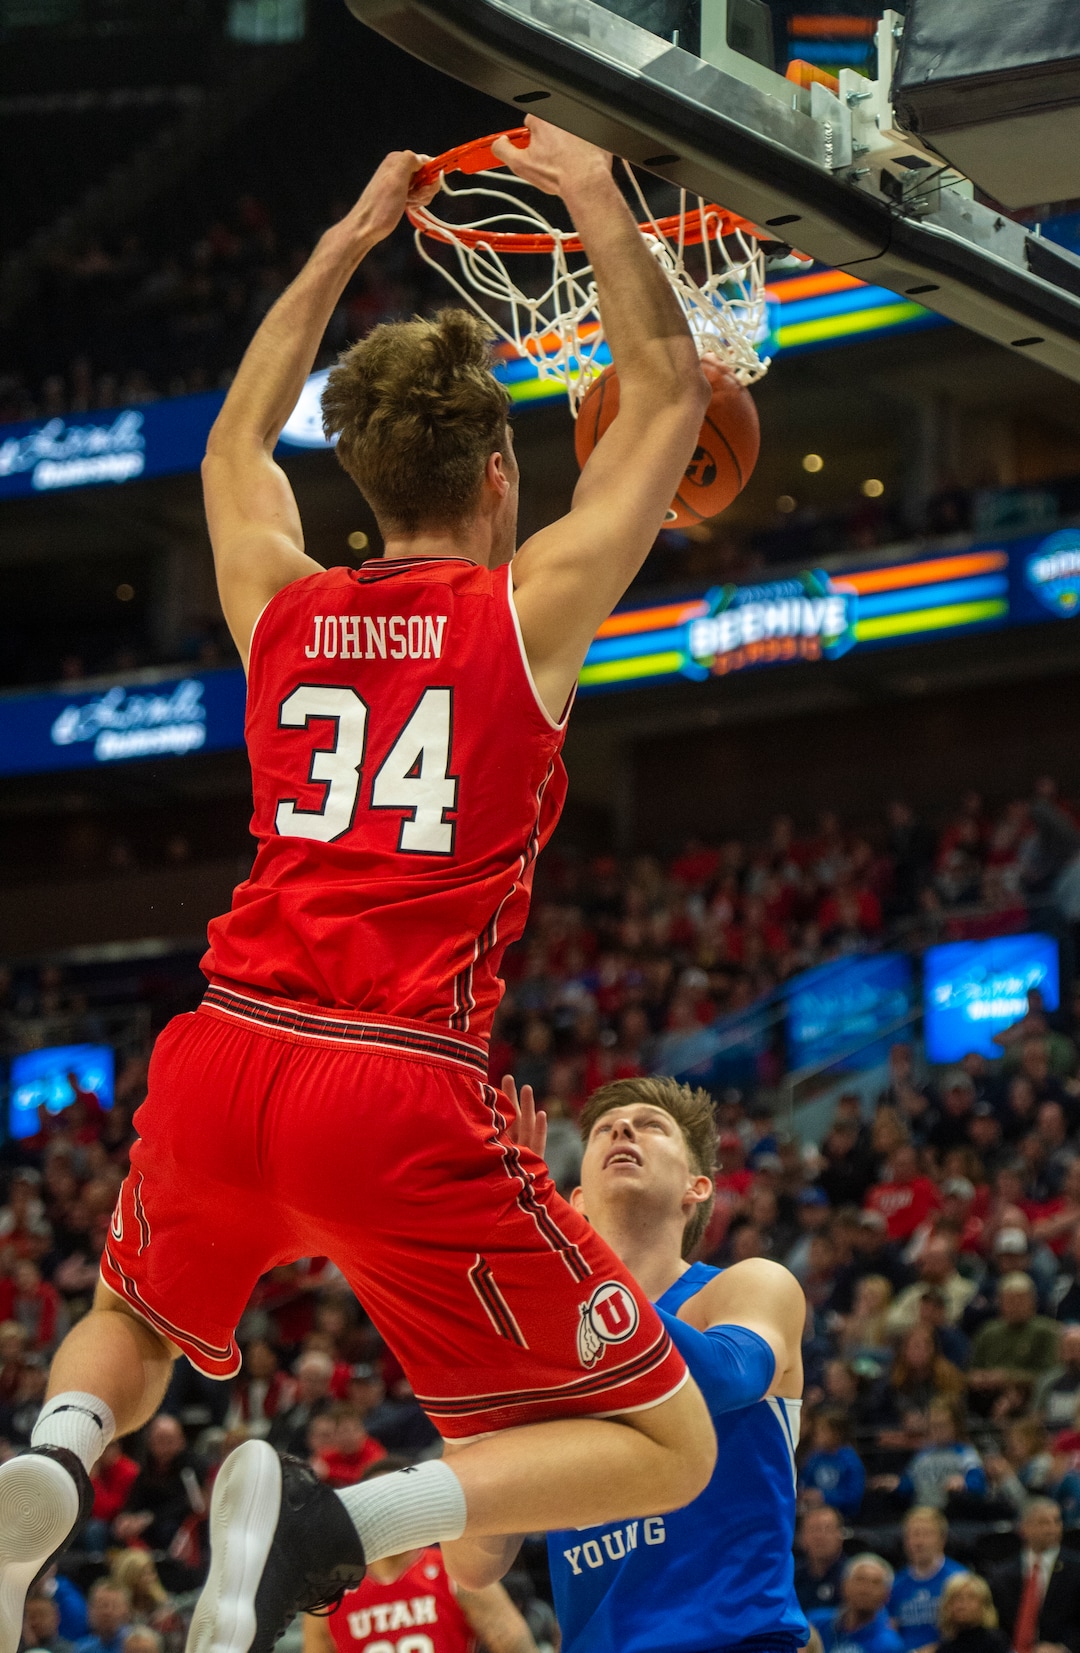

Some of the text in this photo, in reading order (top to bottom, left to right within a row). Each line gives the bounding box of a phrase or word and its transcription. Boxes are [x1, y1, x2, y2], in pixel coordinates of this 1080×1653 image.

[305, 615, 448, 660] JOHNSON
[690, 595, 848, 660] BEEHIVE
[274, 682, 460, 857] 34
[594, 1289, 632, 1336] U
[563, 1516, 666, 1576] YOUNG
[347, 1594, 438, 1640] UTAH
